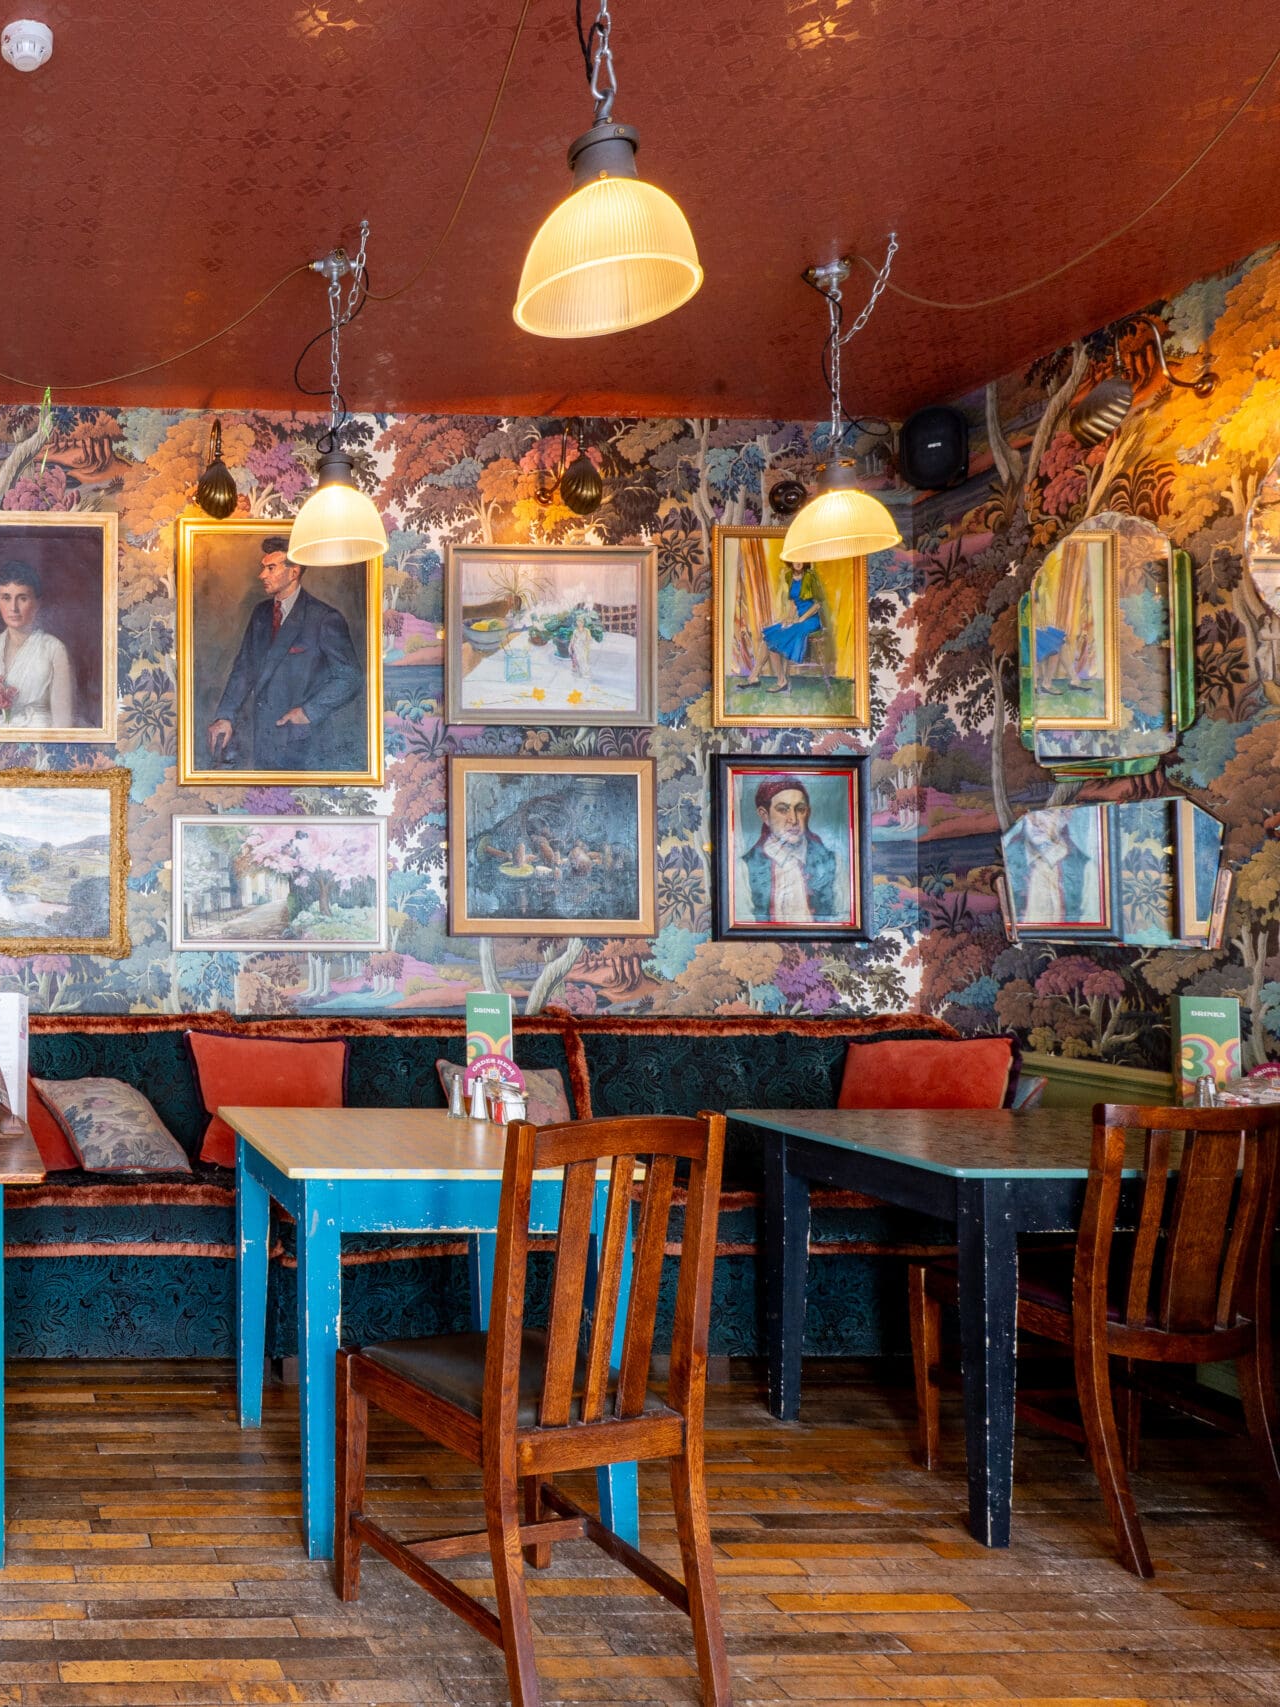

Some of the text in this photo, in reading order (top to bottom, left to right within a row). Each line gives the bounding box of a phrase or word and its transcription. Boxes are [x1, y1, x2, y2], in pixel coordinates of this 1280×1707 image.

[473, 1007, 501, 1015] DRINKS
[1190, 1010, 1226, 1018] DRINKS
[472, 1058, 496, 1072] ORDER
